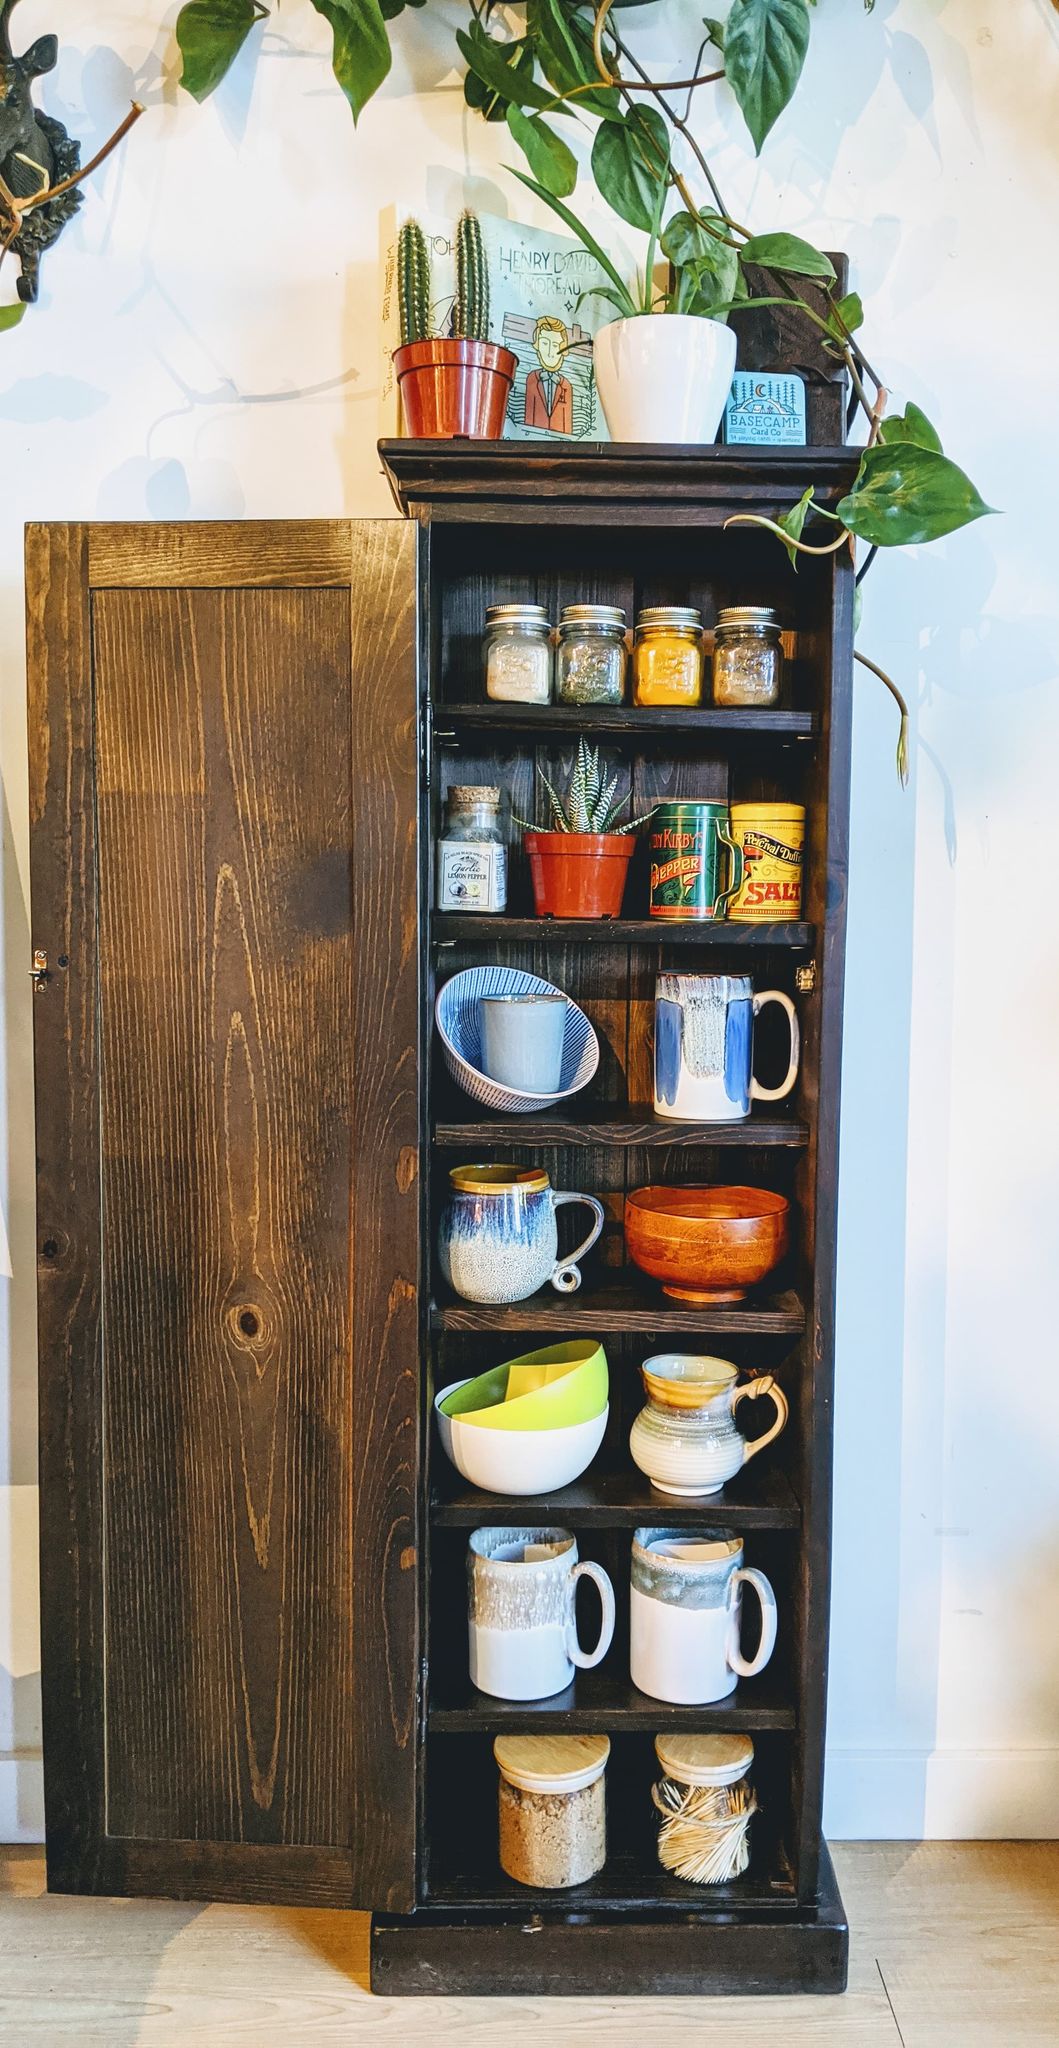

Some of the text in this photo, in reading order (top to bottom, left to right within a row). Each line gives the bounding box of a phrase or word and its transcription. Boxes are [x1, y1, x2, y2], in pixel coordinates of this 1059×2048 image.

[499, 246, 598, 274] HENRY DAVID
[515, 274, 581, 296] THOREAU
[730, 414, 800, 428] BASECAMP
[751, 428, 781, 437] Card Co
[744, 833, 781, 855] Percival
[451, 861, 481, 875] Garlic
[743, 882, 800, 906] SALT
